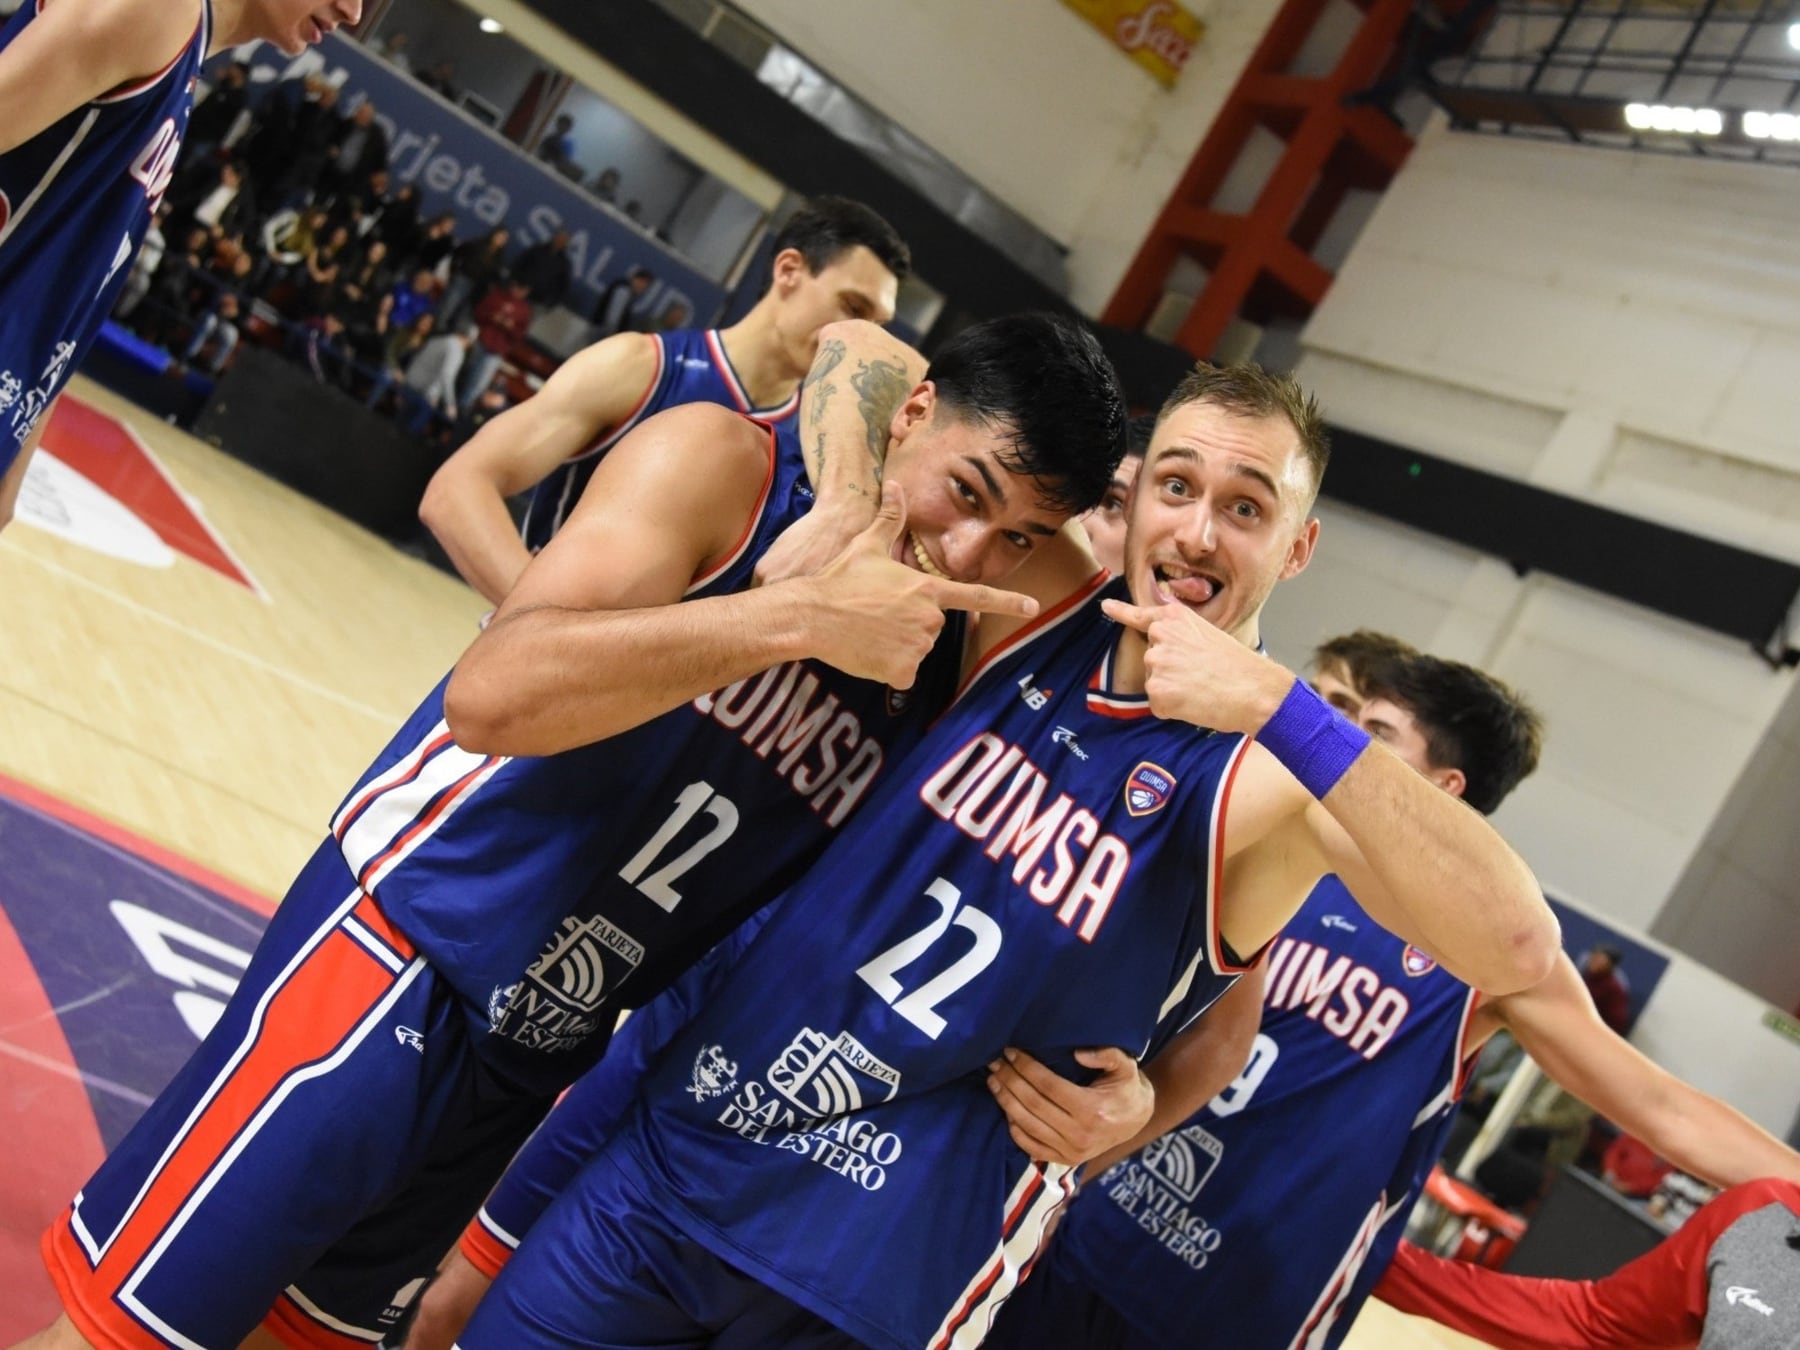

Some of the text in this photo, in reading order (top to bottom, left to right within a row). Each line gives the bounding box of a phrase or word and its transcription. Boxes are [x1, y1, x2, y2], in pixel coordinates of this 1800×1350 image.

[345, 92, 510, 225] rjeta
[694, 660, 884, 828] UIMSA
[1139, 770, 1168, 793] QUIMSA
[618, 780, 739, 913] 12
[591, 918, 642, 964] TARJETA
[855, 876, 1003, 1040] 22
[1262, 934, 1410, 1061] IMSA
[771, 1031, 827, 1090] SOL
[837, 1035, 898, 1084] TARJETA
[717, 1103, 886, 1191] DEL ESTERO
[1109, 1182, 1208, 1269] DEL ESTERO
[1124, 1163, 1221, 1252] SANTIAGO
